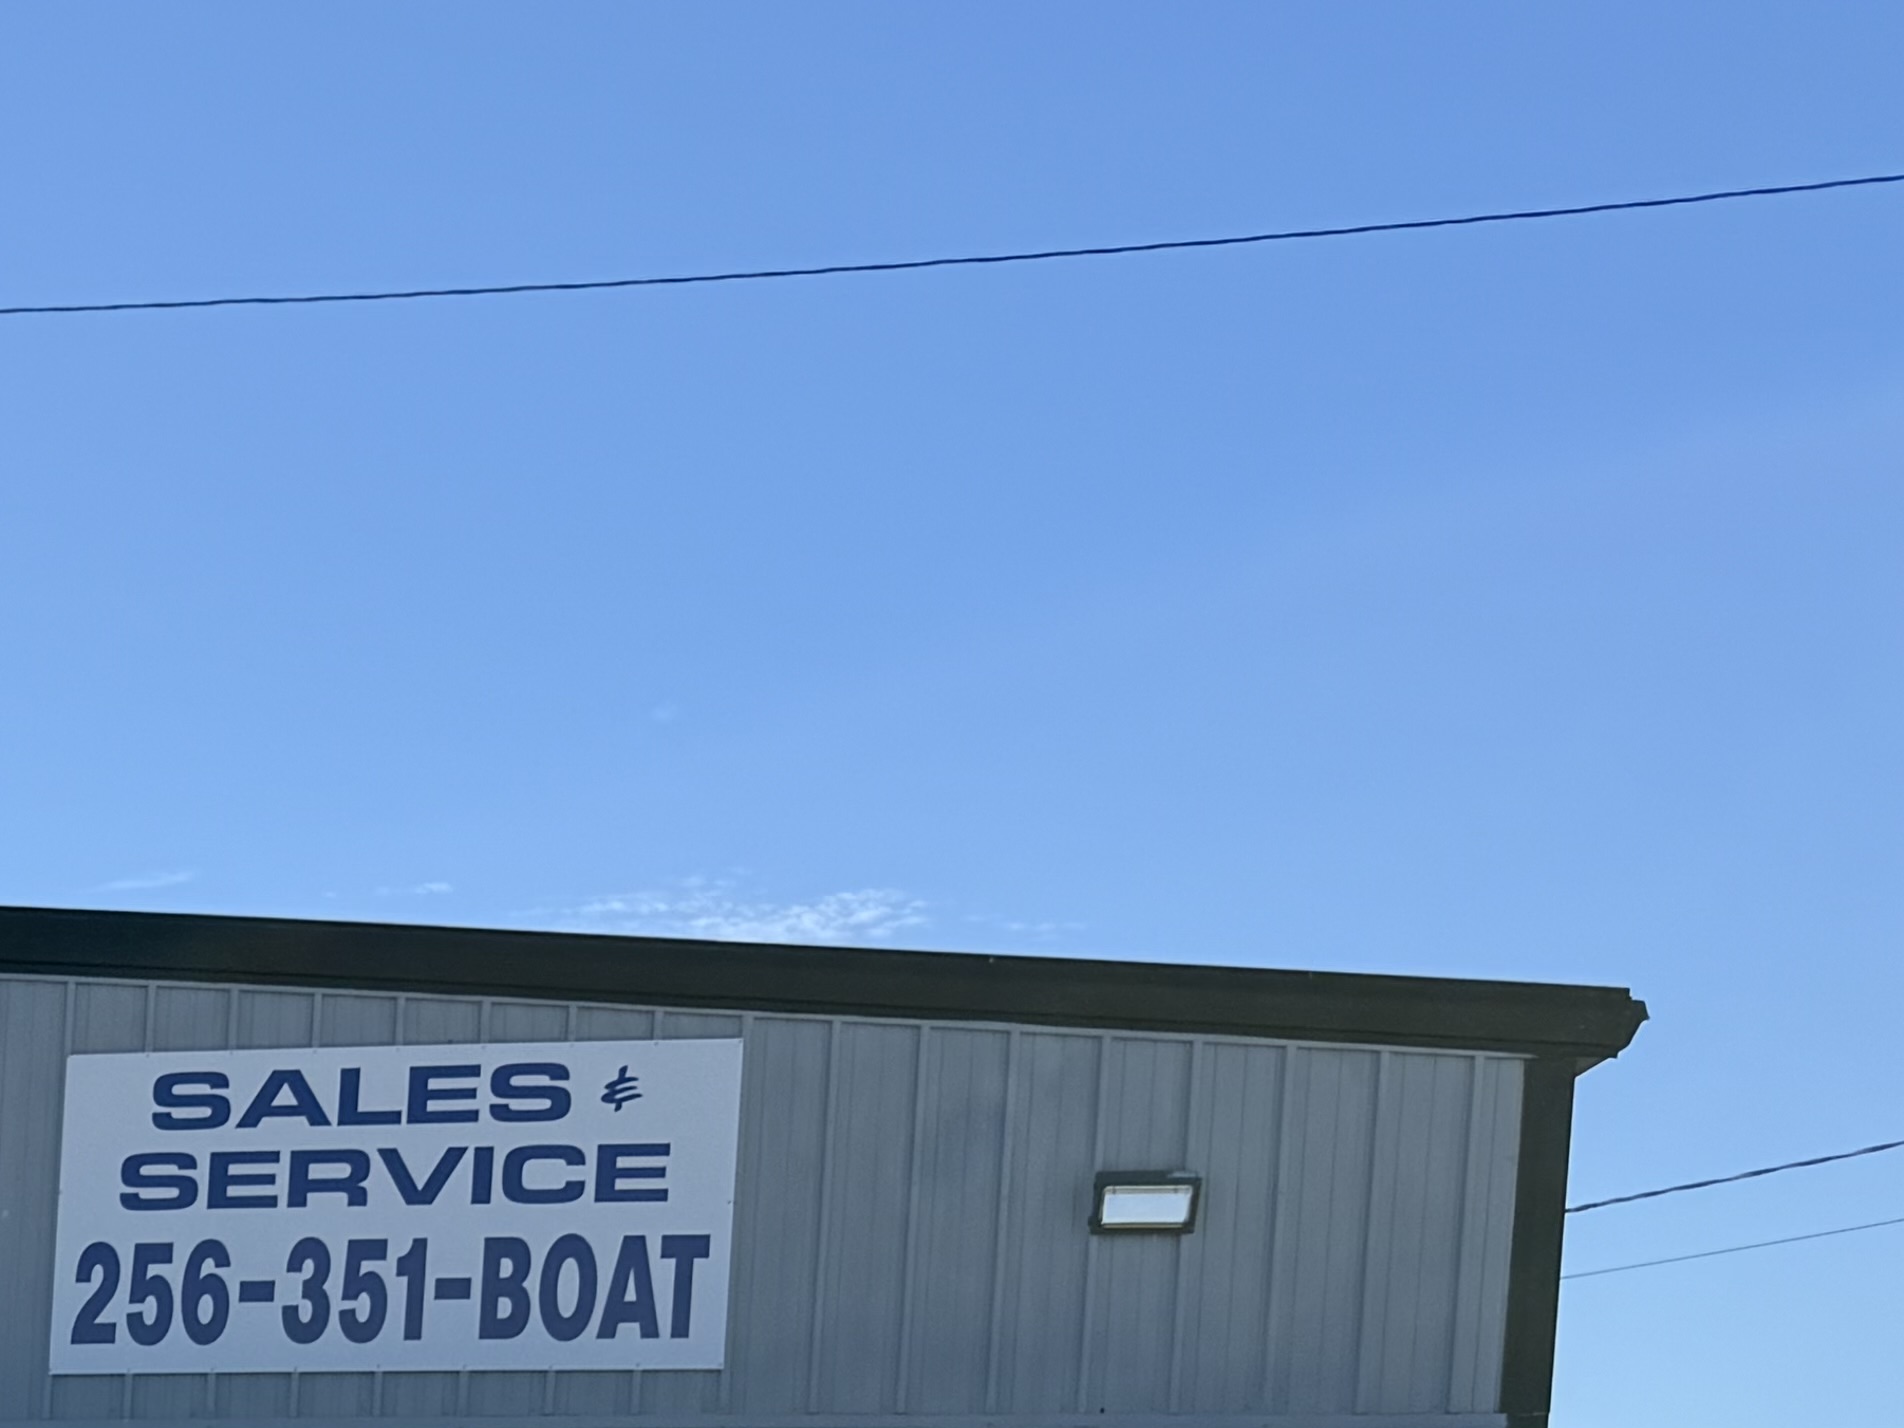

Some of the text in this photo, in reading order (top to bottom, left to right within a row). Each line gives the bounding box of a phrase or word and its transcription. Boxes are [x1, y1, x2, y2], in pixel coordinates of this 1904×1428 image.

[151, 1061, 643, 1131] SALES &
[119, 1142, 672, 1211] SERVICE
[69, 1232, 711, 1346] 256-351-BOAT
